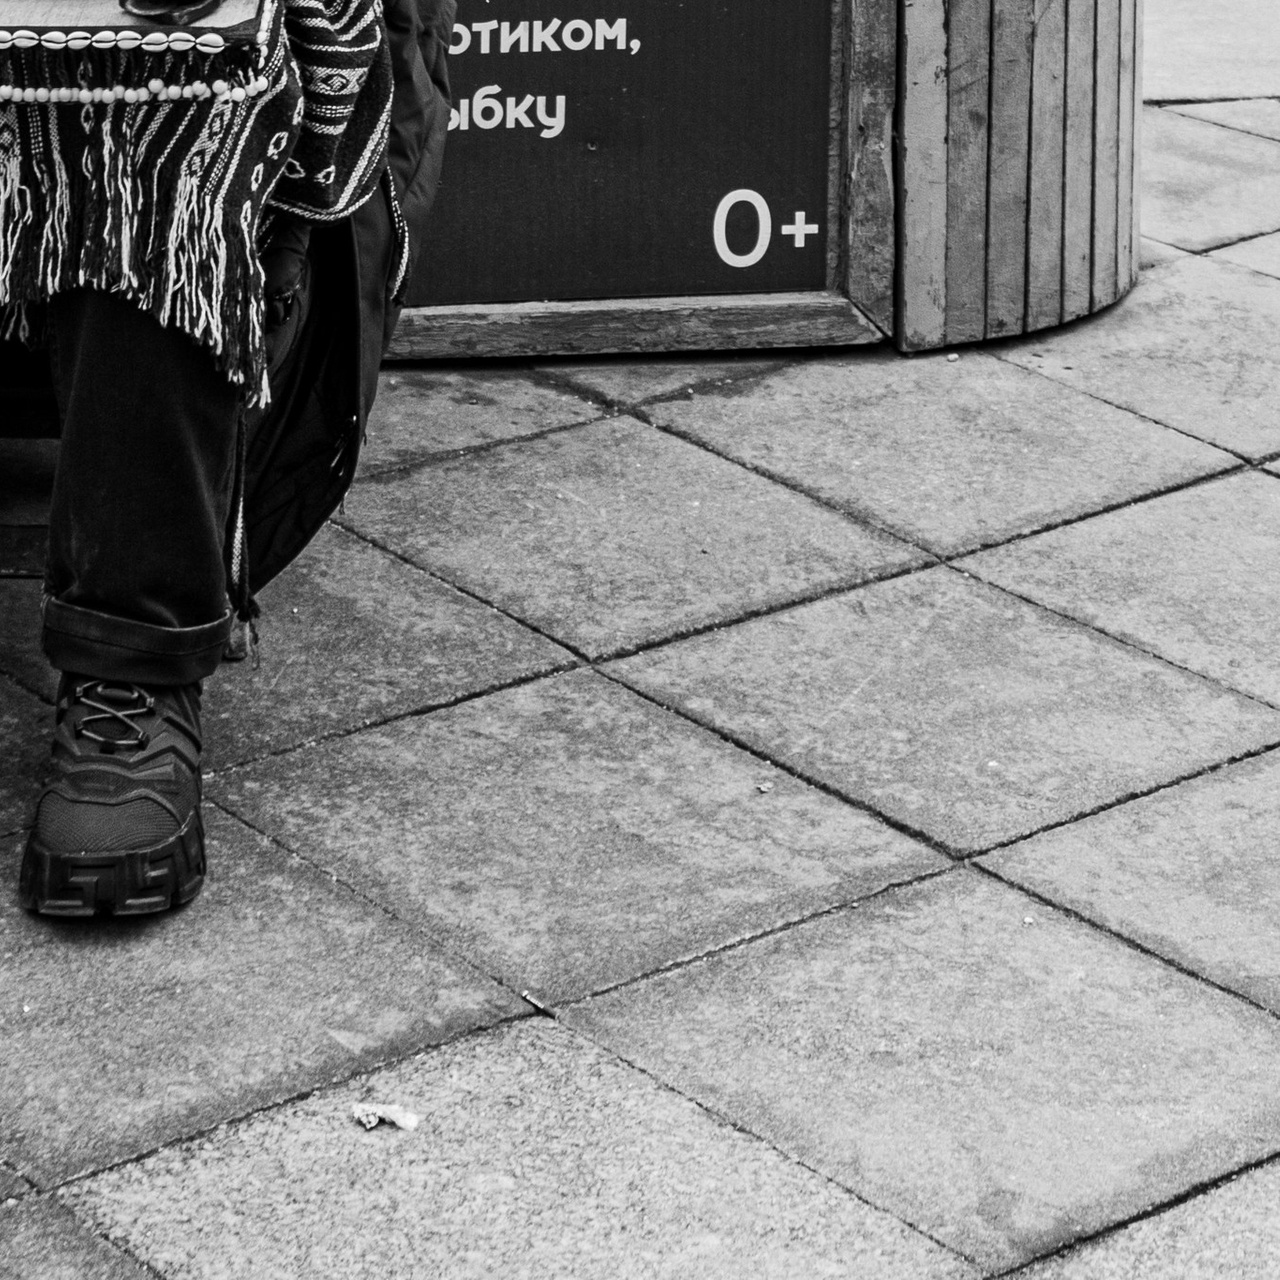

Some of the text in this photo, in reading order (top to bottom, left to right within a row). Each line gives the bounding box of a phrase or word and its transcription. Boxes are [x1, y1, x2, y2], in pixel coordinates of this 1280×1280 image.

[448, 17, 641, 55] отиком,
[447, 84, 567, 139] ыбку
[713, 188, 819, 269] 0+
